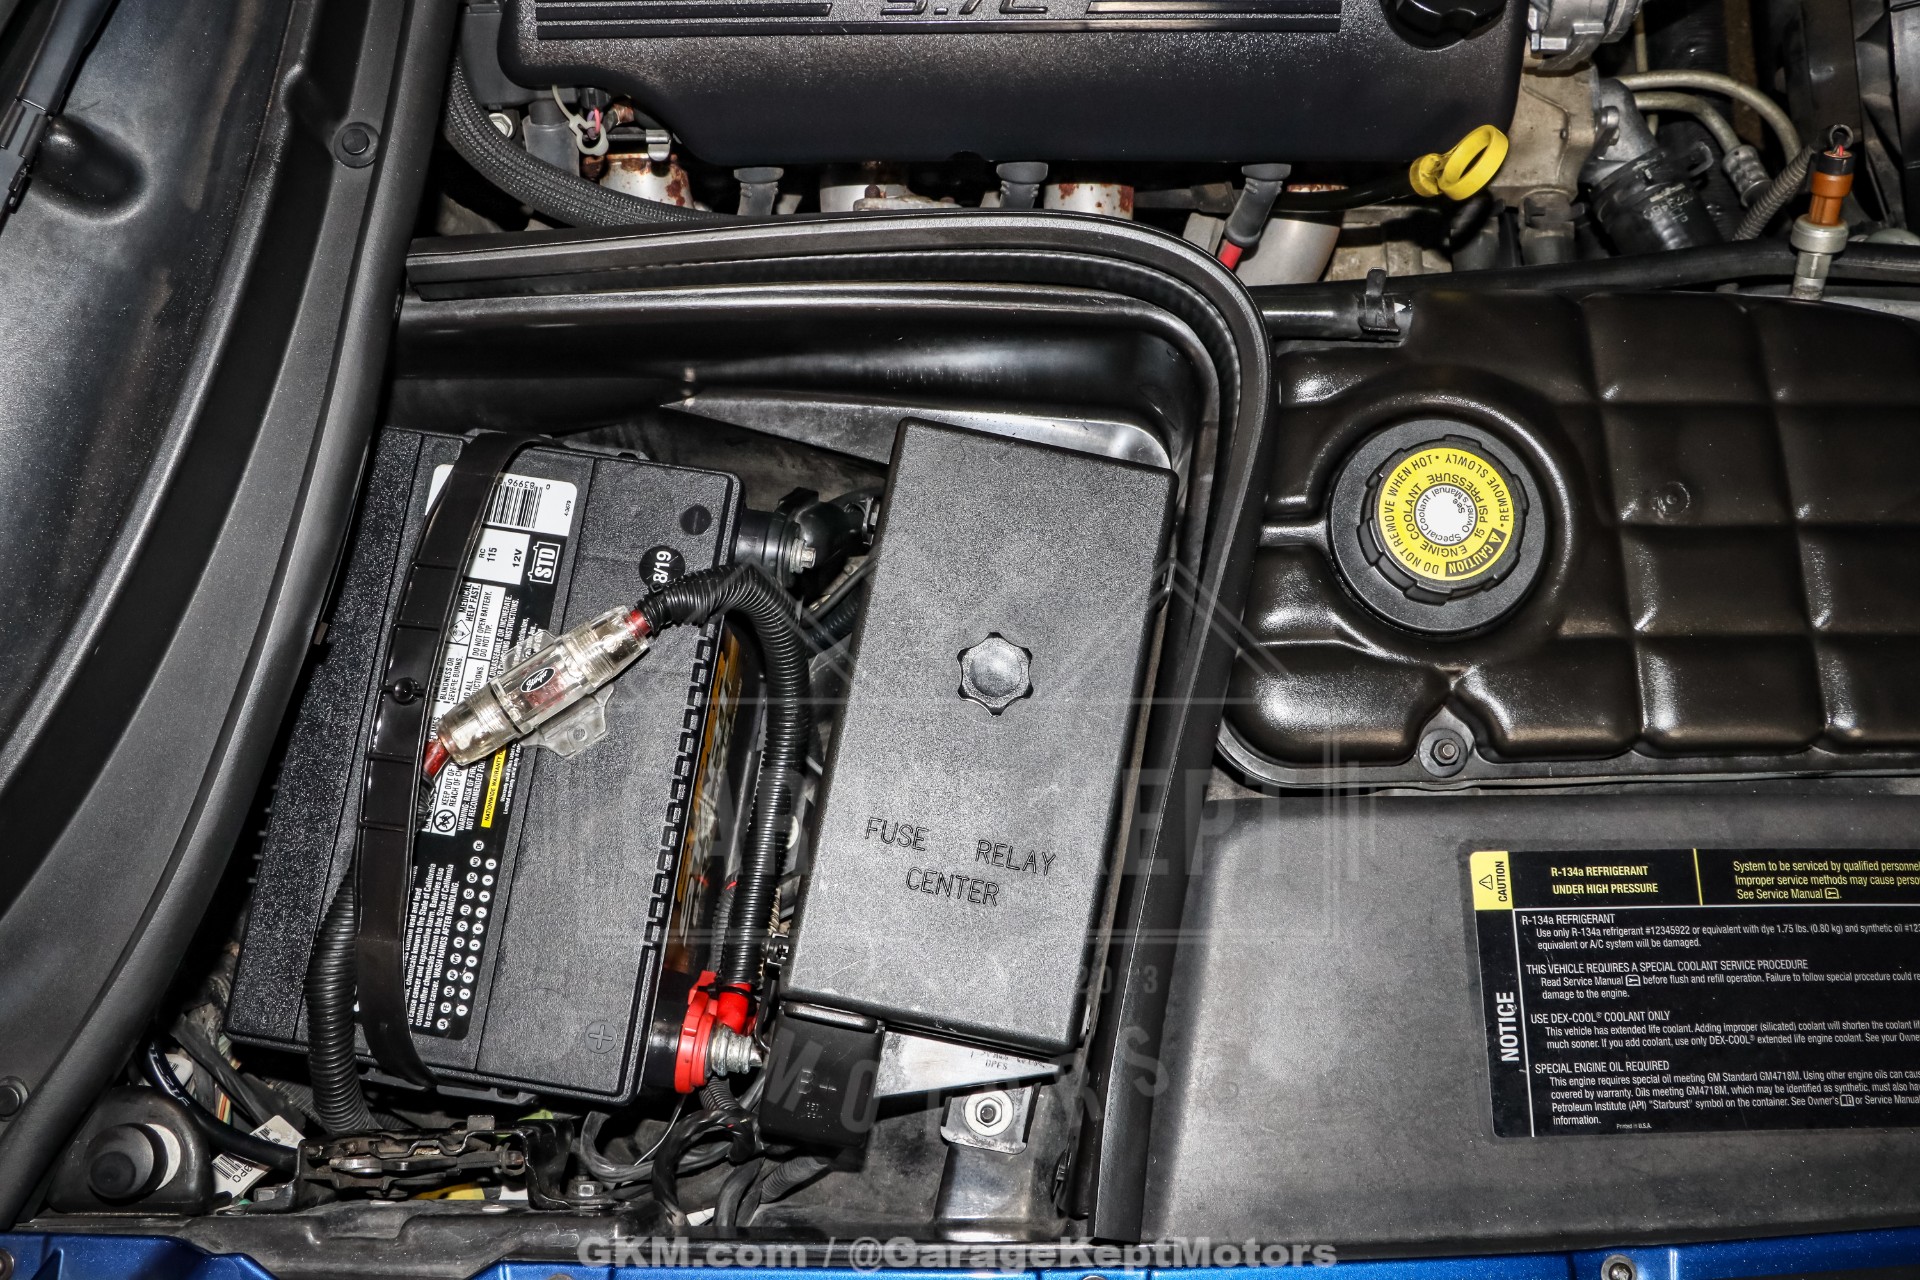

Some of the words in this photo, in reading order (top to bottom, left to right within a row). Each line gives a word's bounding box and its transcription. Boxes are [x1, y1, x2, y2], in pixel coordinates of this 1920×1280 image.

[1411, 454, 1433, 470] HOT
[1445, 454, 1488, 478] SLOWLY
[1387, 467, 1411, 497] WHEN
[1427, 473, 1484, 503] PRESSURE
[1431, 486, 1464, 500] Manual
[1487, 477, 1509, 522] REMOVE
[1404, 483, 1422, 540] COOLANT
[1418, 494, 1431, 531] Coolant
[1452, 499, 1465, 514] See
[1479, 504, 1488, 523] PSI
[1384, 500, 1403, 547] REMOVE
[1426, 530, 1461, 542] Special
[1474, 528, 1485, 539] 15
[479, 548, 486, 558] RC
[487, 547, 498, 562] 115
[512, 548, 523, 568] 12V
[1400, 548, 1421, 567] NOT
[1420, 540, 1467, 557] ENGINE
[534, 548, 556, 579] STD
[652, 550, 672, 584] 8/19
[1424, 562, 1440, 574] DO
[1449, 544, 1494, 574] CAUTION
[459, 584, 472, 614] MEDICAL
[470, 585, 480, 604] FAST.
[466, 606, 475, 622] HELP
[477, 617, 485, 632] OPEN
[481, 591, 492, 616] BATTERY.
[440, 668, 452, 700] BLINDNESS
[448, 679, 456, 702] SEVERE
[449, 787, 459, 807] REACH
[865, 817, 929, 851] FUSE
[975, 839, 1056, 876] RELAY
[1551, 866, 1583, 877] R-134a
[1586, 866, 1649, 876] REFRIGERANT
[1733, 862, 1766, 873] System
[1768, 861, 1777, 871] to
[1779, 861, 1790, 871] be
[1792, 861, 1828, 871] serviced
[1830, 861, 1841, 873] by
[1843, 861, 1879, 873] qualified
[906, 867, 1000, 906] CENTER
[1495, 861, 1507, 902] CAUTION
[1552, 884, 1584, 894] UNDER
[1586, 883, 1608, 894] HIGH
[1610, 882, 1659, 893] PRESSURE
[1735, 875, 1775, 887] Improper
[1777, 875, 1808, 885] service
[1810, 875, 1847, 885] methods
[1849, 877, 1867, 887] may
[1896, 877, 1920, 886] perso
[1737, 889, 1754, 899] See
[1756, 889, 1788, 899] Service
[1790, 888, 1824, 898] Manual
[442, 916, 452, 936] AFTER
[1521, 914, 1553, 925] R-134a
[1556, 914, 1616, 924] REFRIGERANT
[1536, 928, 1551, 937] Use
[1552, 928, 1570, 939] only
[1571, 927, 1601, 936] R-134a
[1602, 926, 1644, 938] refrigerant
[1644, 926, 1690, 936] #12345922
[1701, 925, 1741, 937] equivalent
[1742, 925, 1759, 934] with
[1760, 925, 1774, 936] dye
[1776, 925, 1794, 934] 1.75
[1795, 924, 1809, 934] lbs.
[1830, 924, 1843, 935] kg)
[1844, 924, 1858, 933] and
[1860, 923, 1892, 935] synthetic
[1893, 923, 1902, 932] oil
[437, 934, 449, 956] HANDS
[1537, 940, 1578, 951] equivalent
[1589, 939, 1603, 948] A/C
[1605, 939, 1633, 950] system
[1635, 939, 1649, 948] will
[1650, 938, 1661, 948] be
[1662, 938, 1702, 949] damaged.
[433, 957, 444, 978] WASH
[1526, 964, 1546, 974] THIS
[1547, 963, 1585, 974] VEHICLE
[1586, 962, 1630, 973] REQUIRES
[1630, 962, 1638, 972] A
[1639, 962, 1676, 972] SPECIAL
[1677, 961, 1718, 972] COOLANT
[1720, 960, 1756, 971] SERVICE
[1757, 959, 1809, 970] PROCEDURE
[1541, 977, 1561, 986] Read
[1562, 976, 1592, 986] Service
[1594, 976, 1623, 986] Manual
[1642, 975, 1668, 985] before
[1669, 975, 1689, 984] flush
[1690, 975, 1705, 984] and
[1707, 974, 1724, 984] refill
[1725, 974, 1764, 985] operation.
[1765, 973, 1791, 983] Failure
[1792, 973, 1800, 982] to
[1802, 973, 1824, 982] follow
[1826, 972, 1852, 984] special
[1854, 972, 1890, 984] procedure
[1892, 972, 1912, 981] could
[1542, 990, 1574, 1001] damage
[1575, 989, 1584, 999] to
[1585, 989, 1599, 998] the
[1600, 988, 1631, 1000] engine.
[1496, 991, 1520, 1062] NOTICE
[1530, 1013, 1548, 1023] USE
[1604, 1011, 1645, 1022] COOLANT
[1647, 1011, 1671, 1021] ONLY
[1535, 1062, 1572, 1074] SPECIAL
[1574, 1062, 1607, 1073] ENGINE
[1608, 1061, 1623, 1072] OIL
[1625, 1060, 1670, 1071] REQUIRED
[1553, 1115, 1602, 1125] information.
